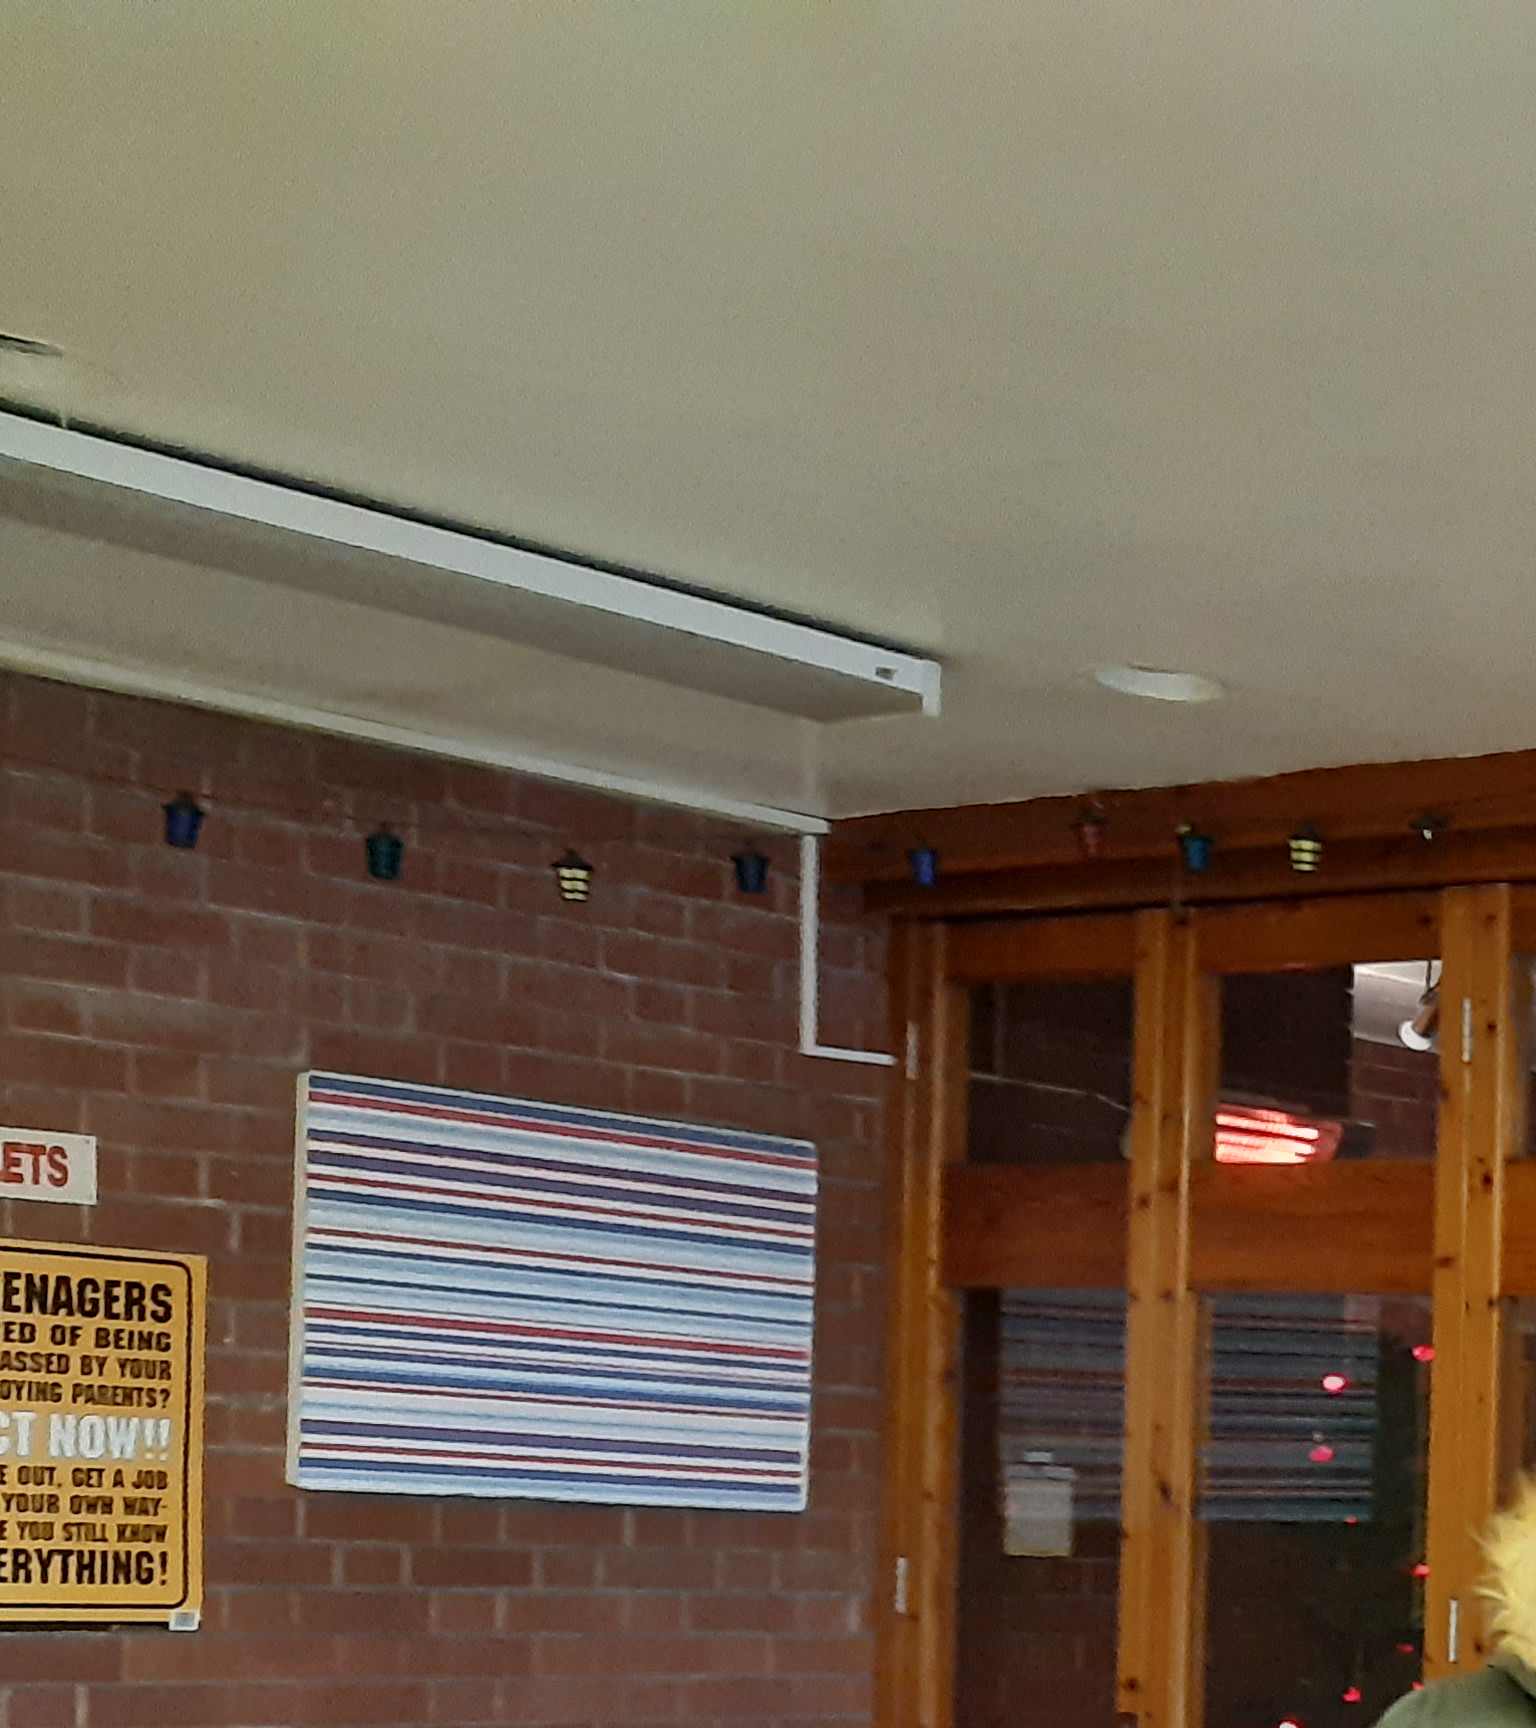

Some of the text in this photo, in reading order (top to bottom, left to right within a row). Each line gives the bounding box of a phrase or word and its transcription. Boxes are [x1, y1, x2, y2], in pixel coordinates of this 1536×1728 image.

[0, 1142, 69, 1187] ETS
[2, 1271, 172, 1323] ENAGERS
[3, 1321, 172, 1352] ED OF BEING
[80, 1355, 108, 1377] BY
[117, 1358, 172, 1381] YOUR
[72, 1382, 171, 1409] PARENTS?
[50, 1413, 171, 1461] NOW!!
[71, 1467, 106, 1488] GET
[113, 1468, 125, 1488] A
[132, 1469, 168, 1490] JOB
[2, 1492, 60, 1513] YOUR
[70, 1494, 114, 1515] OWN
[17, 1520, 55, 1541] YOU
[62, 1522, 108, 1542] STILL
[116, 1523, 169, 1543] KNOW
